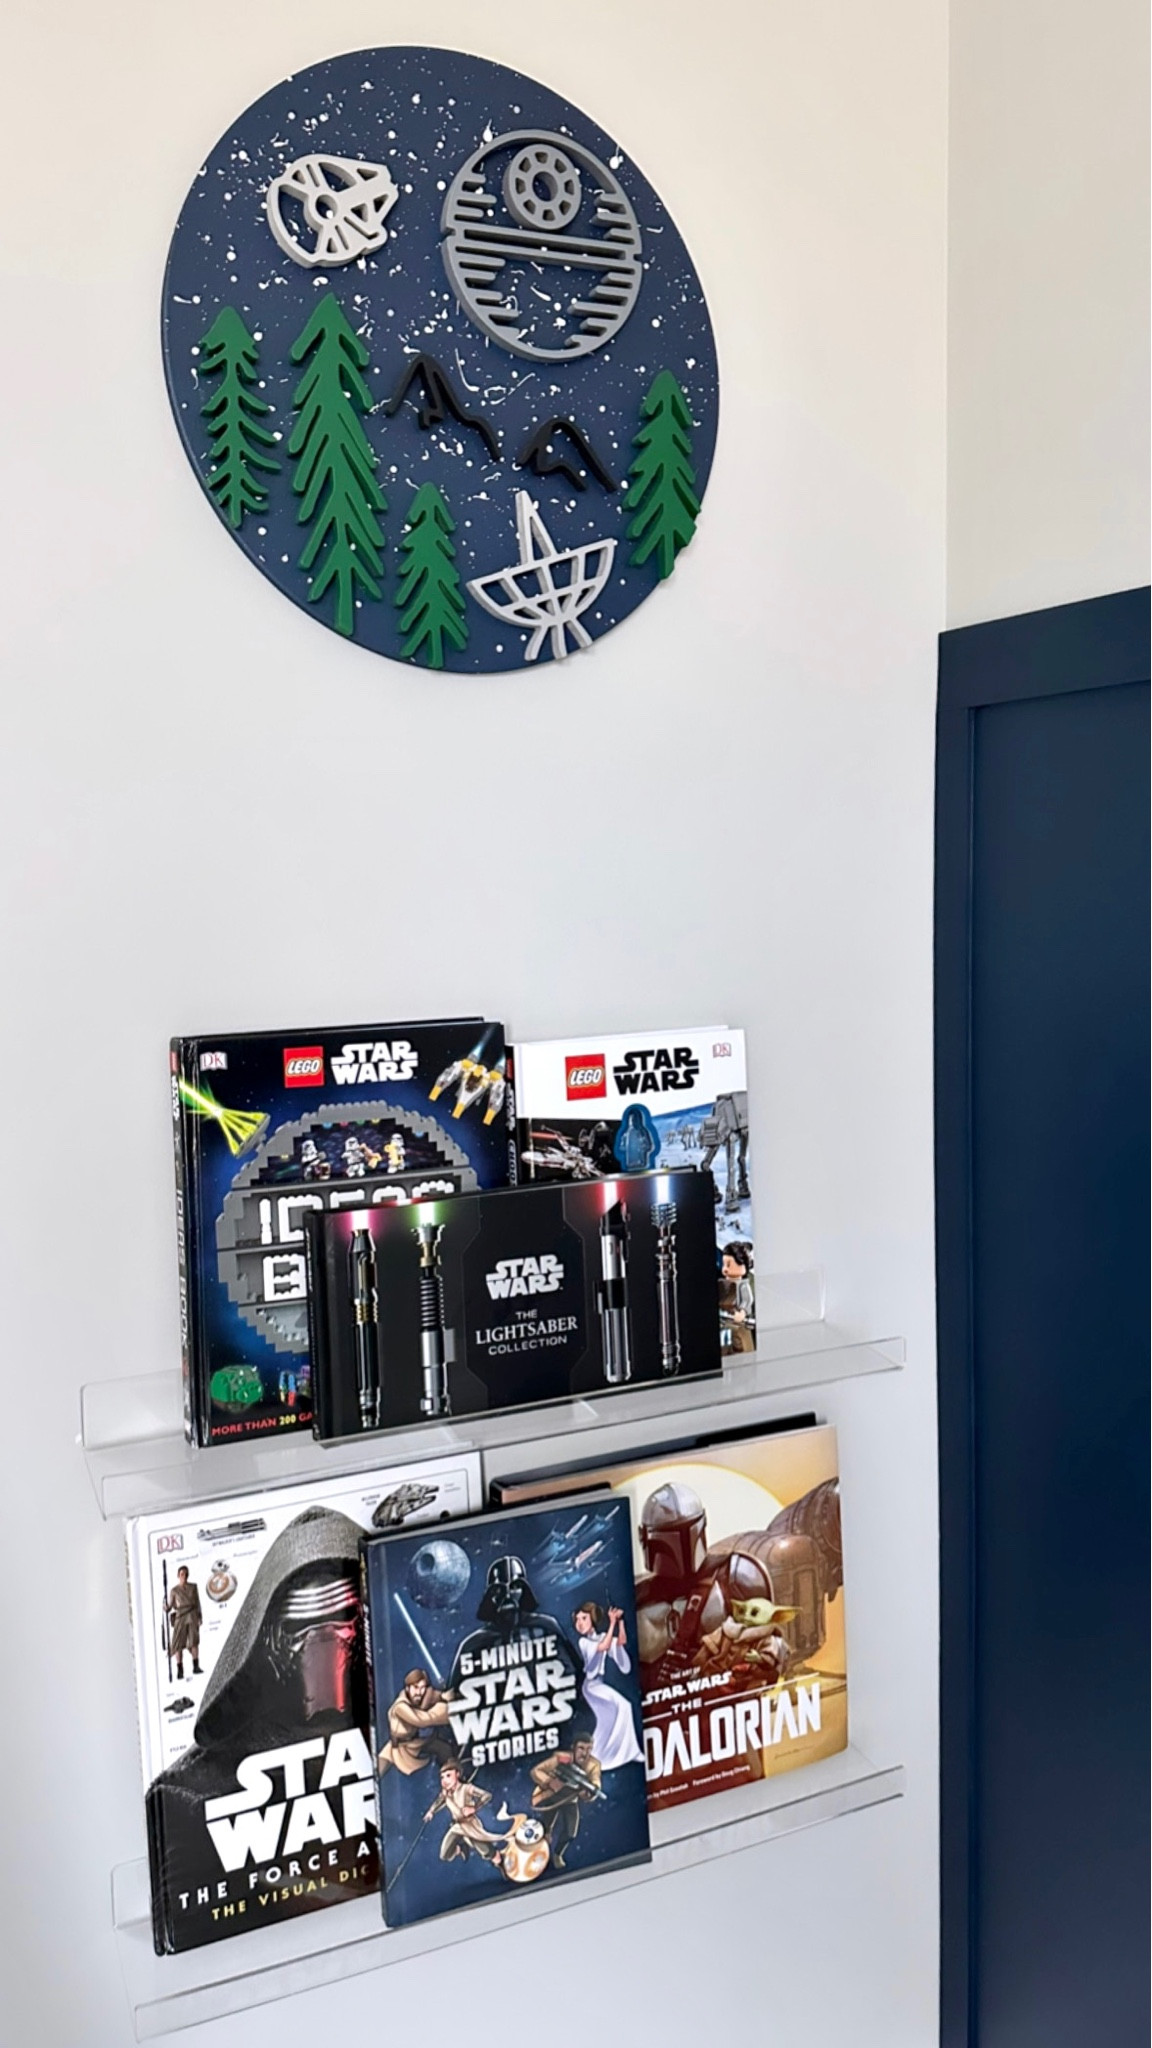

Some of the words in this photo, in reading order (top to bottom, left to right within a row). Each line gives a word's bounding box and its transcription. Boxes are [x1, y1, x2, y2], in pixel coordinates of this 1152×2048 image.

[202, 1053, 225, 1069] DK
[331, 1041, 418, 1065] STAR
[613, 1047, 699, 1073] STAR
[286, 1059, 321, 1075] LEGO
[331, 1059, 418, 1085] WARS
[569, 1068, 602, 1086] LEGO
[613, 1068, 700, 1095] WARS
[486, 1254, 564, 1281] STAR
[486, 1271, 564, 1300] WARS
[516, 1309, 538, 1320] THE
[475, 1316, 578, 1345] LIGHTSABER
[488, 1335, 568, 1356] COLLECTION
[212, 1423, 243, 1436] MORE
[245, 1417, 277, 1431] THAN
[279, 1414, 297, 1426] 200
[159, 1534, 183, 1554] DK
[460, 1634, 558, 1676] 5-MINUTE
[448, 1659, 576, 1714] STAR
[641, 1684, 687, 1707] STAR
[686, 1670, 733, 1694] WARS
[448, 1688, 577, 1746] WARS
[671, 1696, 702, 1714] THE
[642, 1681, 822, 1782] DALORIAN
[471, 1727, 560, 1767] STORIES
[204, 1727, 374, 1822] STA
[205, 1778, 378, 1873] WAR
[178, 1881, 228, 1910] THE
[248, 1849, 339, 1889] FORCE
[211, 1900, 246, 1920] THE
[258, 1876, 328, 1906] VISUAL
